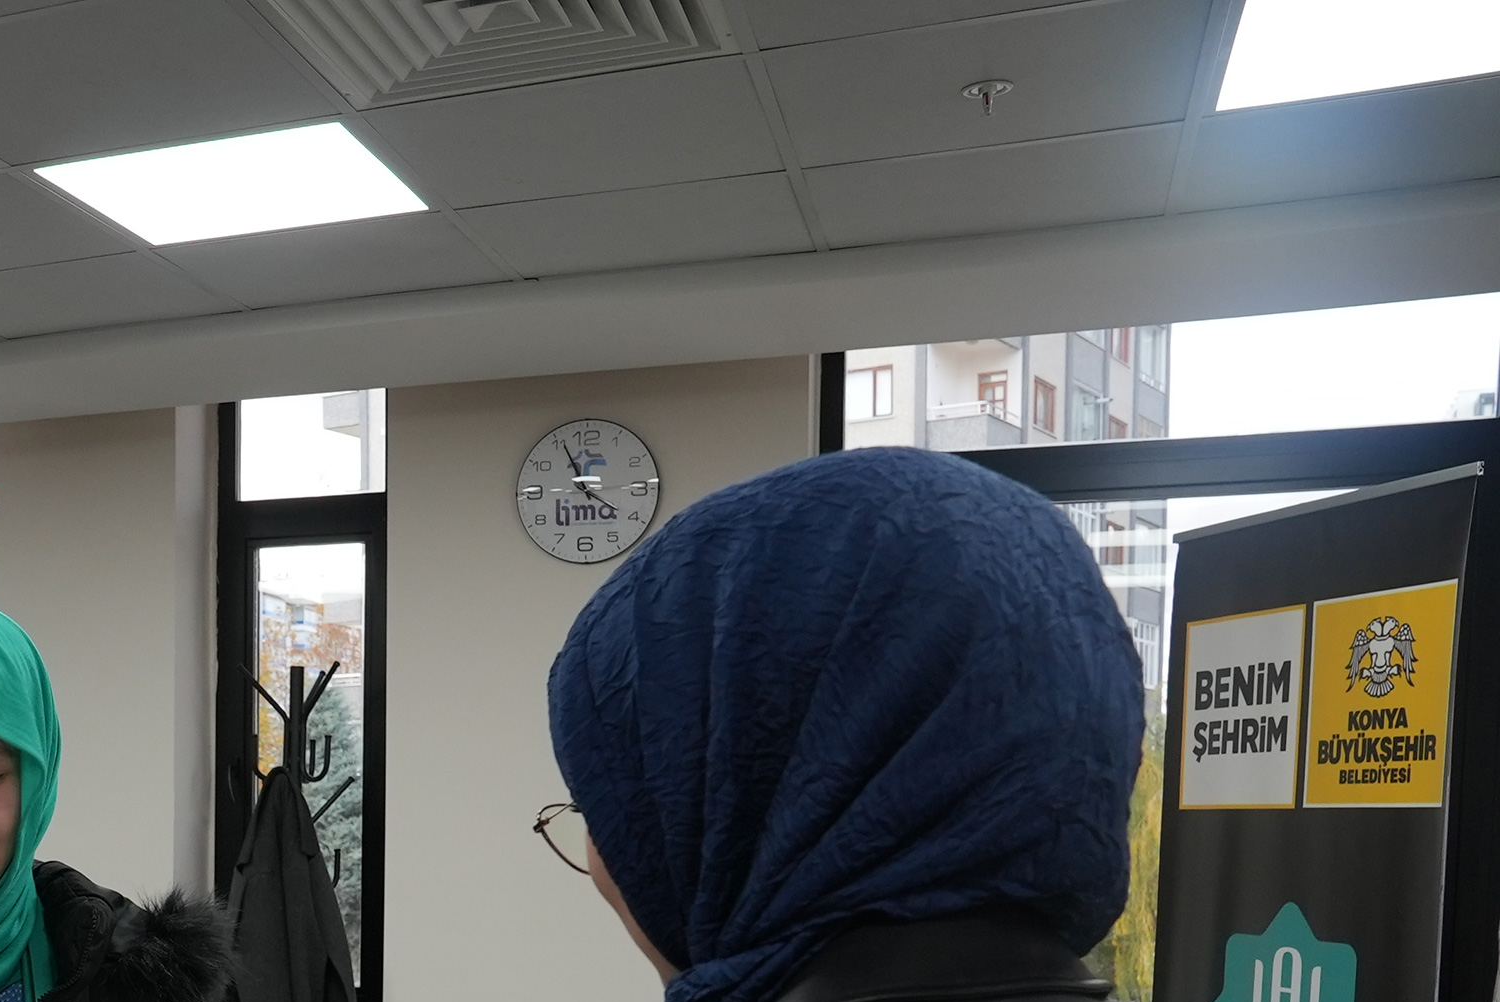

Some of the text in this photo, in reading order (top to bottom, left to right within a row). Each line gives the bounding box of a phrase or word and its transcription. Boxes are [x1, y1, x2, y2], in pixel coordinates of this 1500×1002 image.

[572, 430, 601, 447] 12
[612, 436, 619, 447] 1
[532, 460, 552, 472] 10
[628, 456, 641, 467] 2
[526, 484, 543, 500] 9
[630, 480, 648, 497] 3
[534, 514, 547, 526] 8
[555, 499, 618, 526] lima
[627, 511, 640, 522] 4
[554, 533, 566, 544] 7
[577, 536, 594, 552] 6
[606, 531, 619, 543] 5
[1194, 660, 1292, 711] BENİM
[1347, 707, 1409, 732] KONYA
[1192, 715, 1289, 763] ŞEHRİM
[1317, 729, 1437, 767] BÜYÜKŞEHİR
[1338, 763, 1411, 785] BELEDİYESİ
